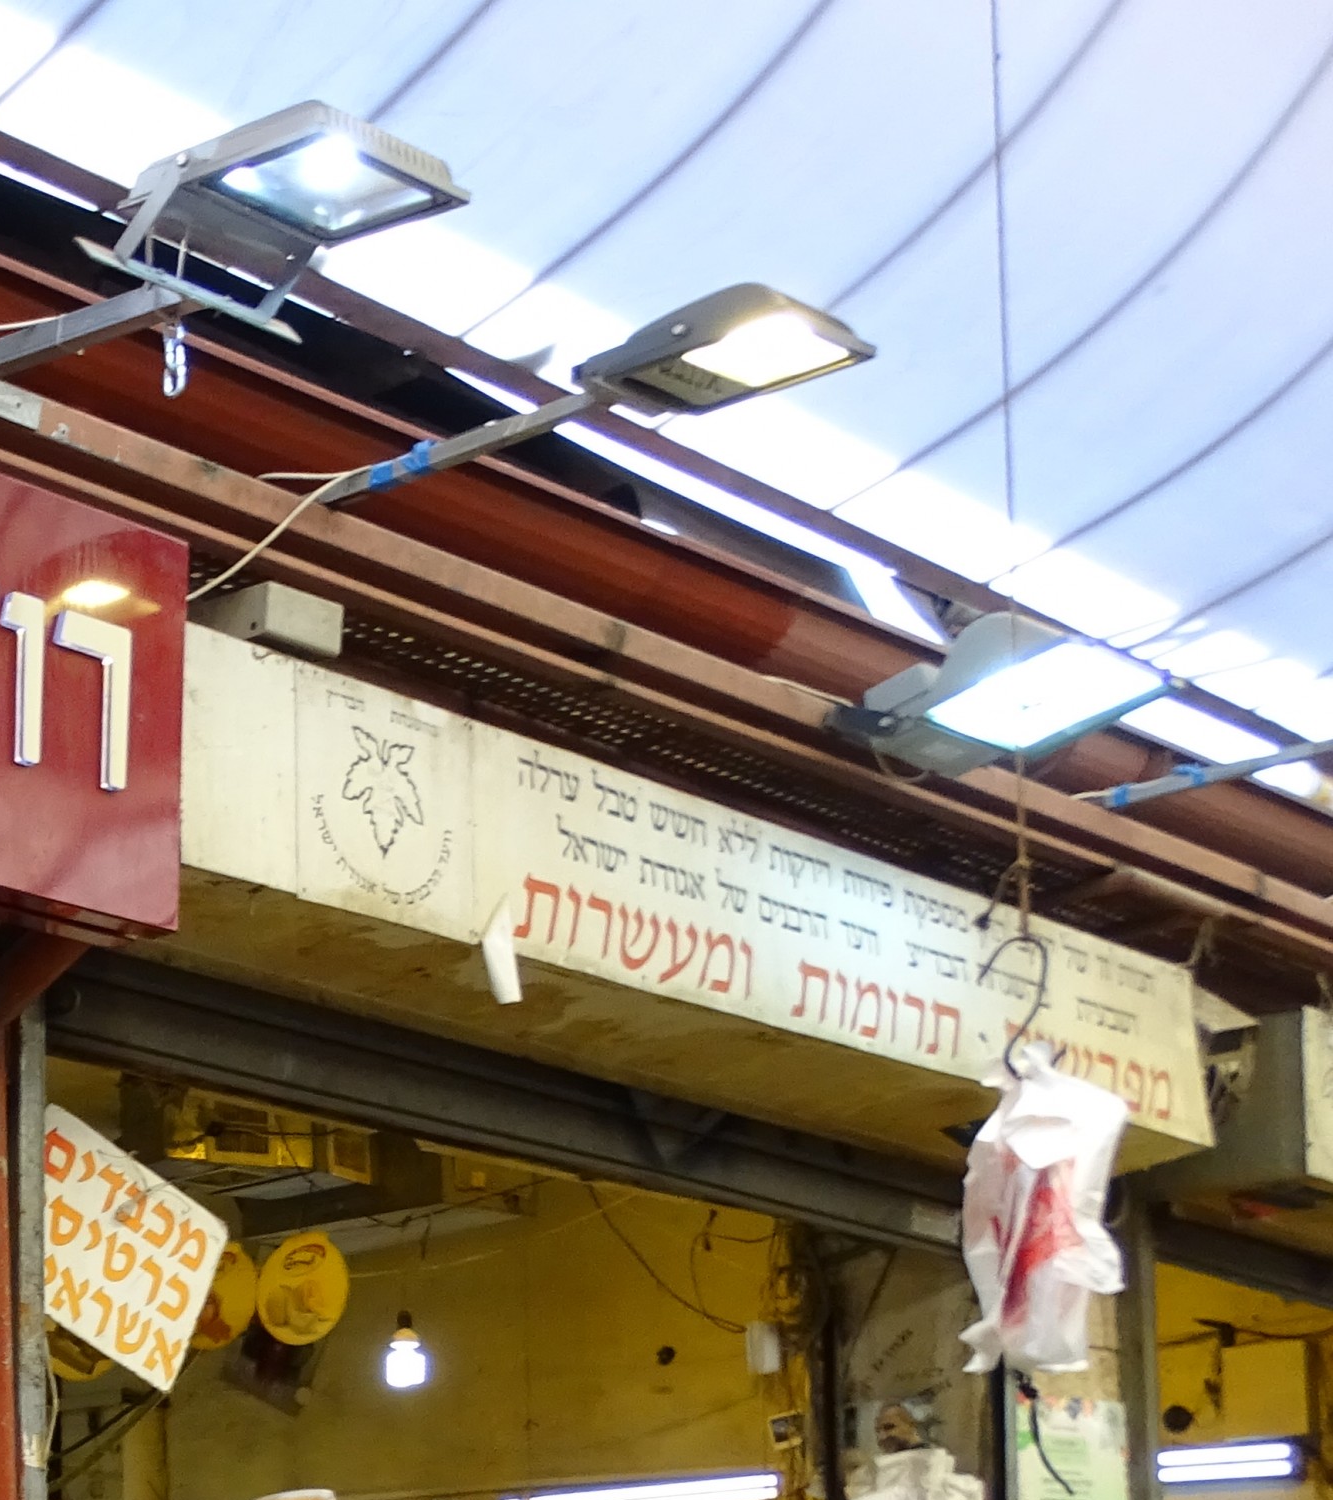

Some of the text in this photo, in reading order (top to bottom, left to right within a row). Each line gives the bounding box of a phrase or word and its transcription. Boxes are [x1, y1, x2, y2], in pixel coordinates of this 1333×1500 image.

[555, 812, 628, 873] ישראל
[511, 872, 755, 1000] ומעשרות
[791, 958, 962, 1060] תרומות
[43, 1126, 209, 1273] מכבדים
